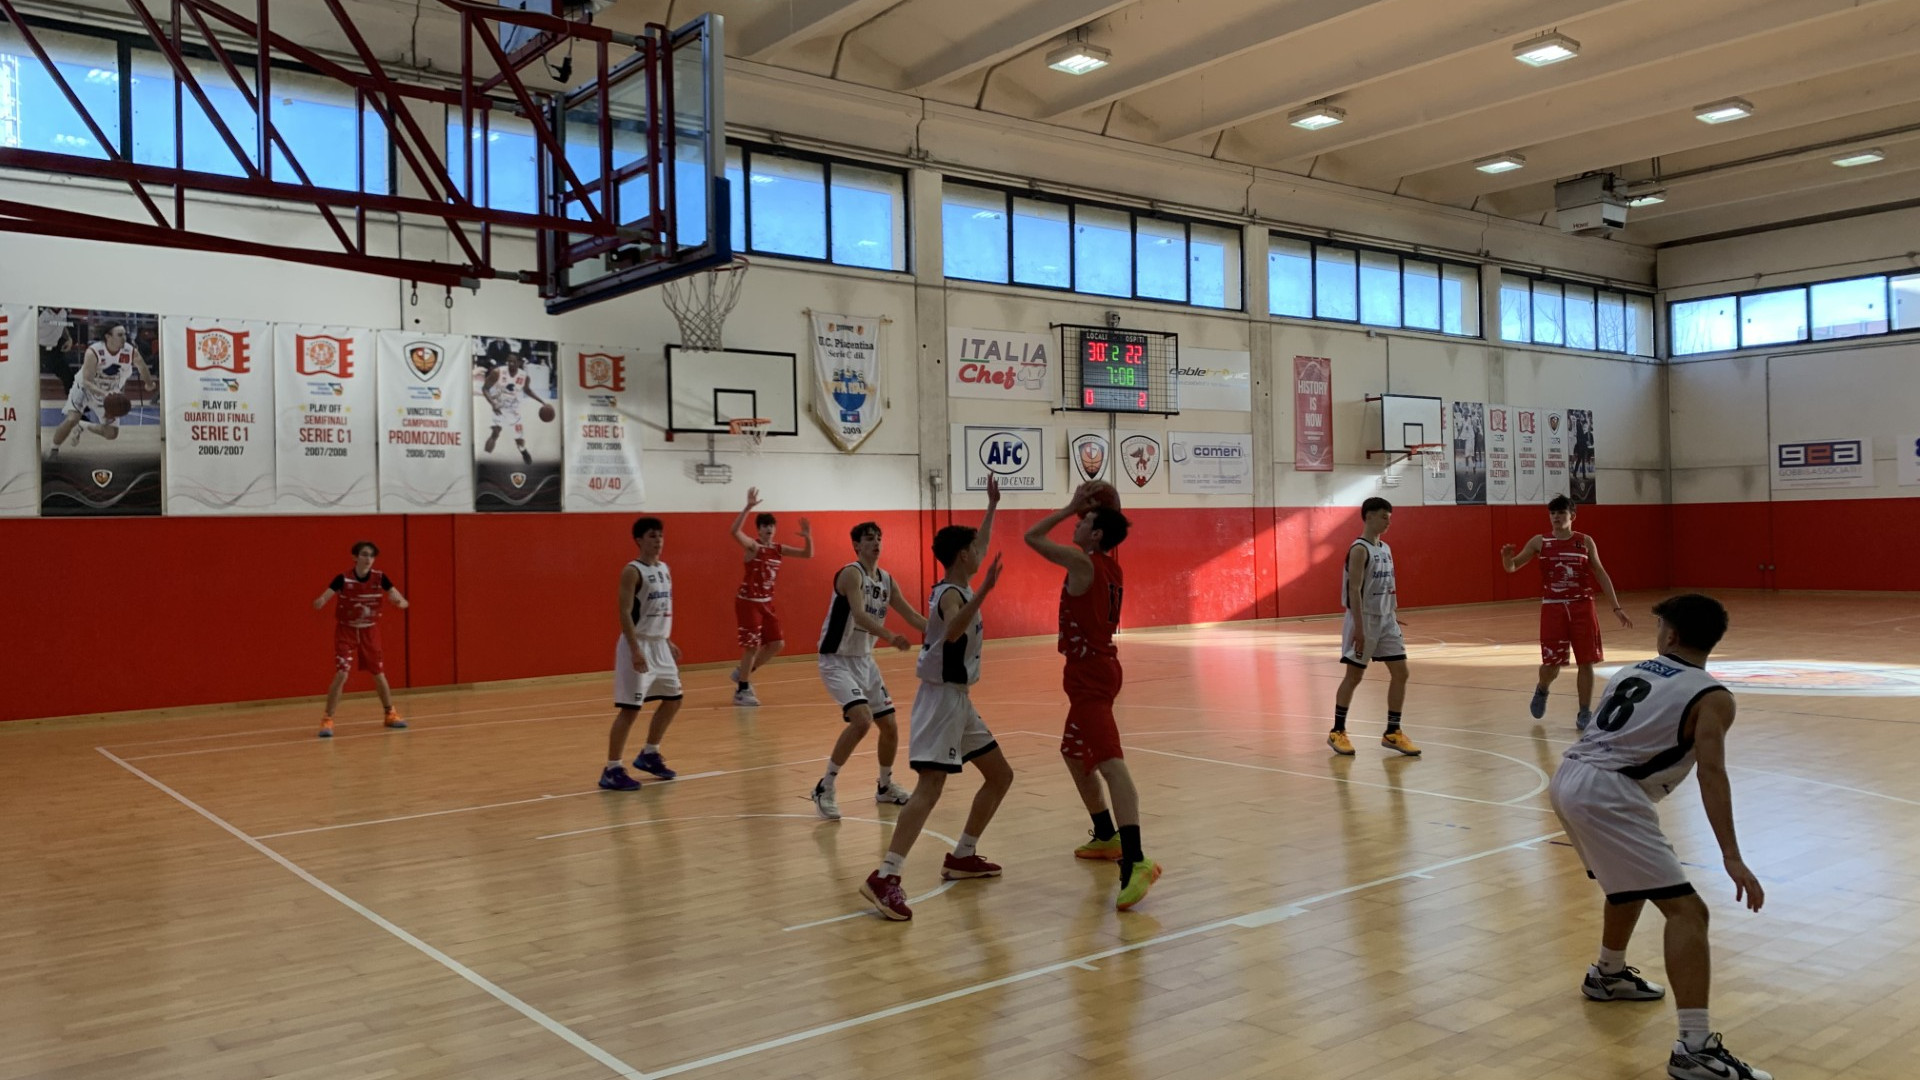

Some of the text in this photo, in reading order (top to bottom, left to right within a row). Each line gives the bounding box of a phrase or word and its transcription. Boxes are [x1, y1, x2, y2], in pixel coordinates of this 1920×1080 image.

[1086, 332, 1108, 340] LOCALI
[835, 339, 874, 350] Piacentina
[960, 338, 1048, 364] ITALIA
[1088, 342, 1143, 364] 30 2 22
[958, 363, 1016, 390] Chef
[1106, 366, 1135, 386] 7:08
[1298, 379, 1328, 395] HISTORY
[202, 400, 238, 410] PLAY OFF
[1085, 388, 1147, 408] 0 2
[1309, 397, 1317, 411] IS
[309, 403, 342, 413] PLAY OFF
[406, 408, 443, 417] VINCITRICE
[184, 411, 256, 424] QUARTI DI FINALE
[304, 415, 348, 425] SEMIFINALI
[402, 418, 449, 428] CAMPIONATO
[1305, 413, 1323, 427] NOW
[191, 425, 229, 441] SERIE
[299, 428, 334, 443] SERIE
[388, 430, 462, 446] PROMOZIONE
[582, 425, 610, 438] SERIE
[198, 445, 245, 456] 2006/2007
[304, 447, 348, 457] 2007/2008
[987, 441, 1023, 466] AFC
[1193, 443, 1241, 457] comeri
[588, 477, 622, 491] 40/40
[1009, 476, 1035, 487] CENTER
[1596, 676, 1652, 732] 8
